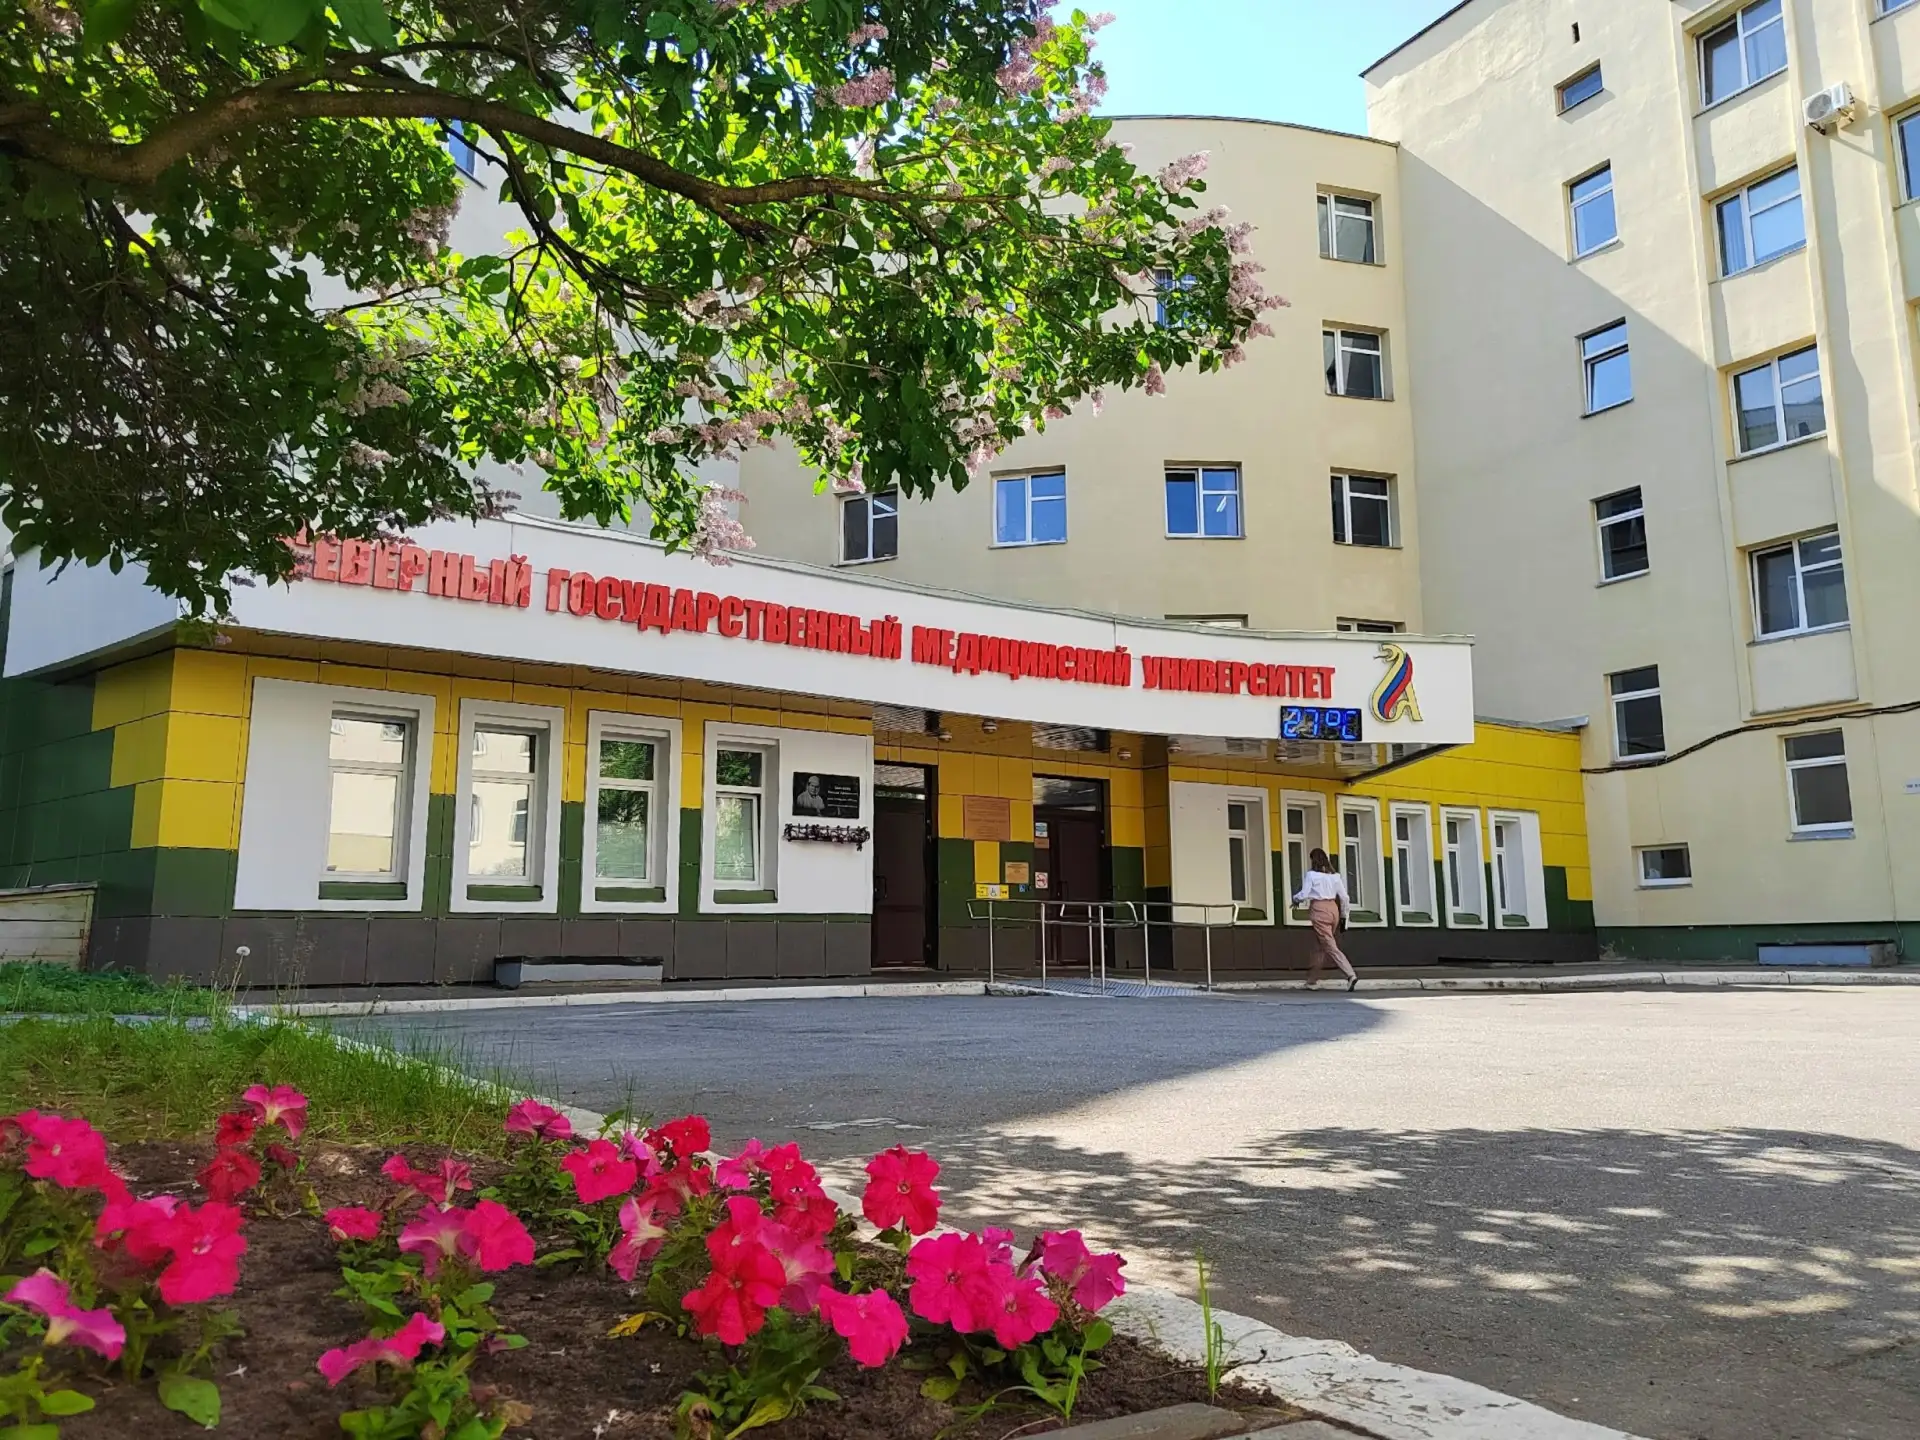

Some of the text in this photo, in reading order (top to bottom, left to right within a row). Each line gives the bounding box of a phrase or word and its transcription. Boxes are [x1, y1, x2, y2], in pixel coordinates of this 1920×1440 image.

[546, 567, 901, 660] ГОСУДАРСТВЕННЫЙ
[912, 625, 1131, 687] МЕДИЦИНСКИЙ
[1142, 655, 1335, 699] УНИВЕРСИТЕТ
